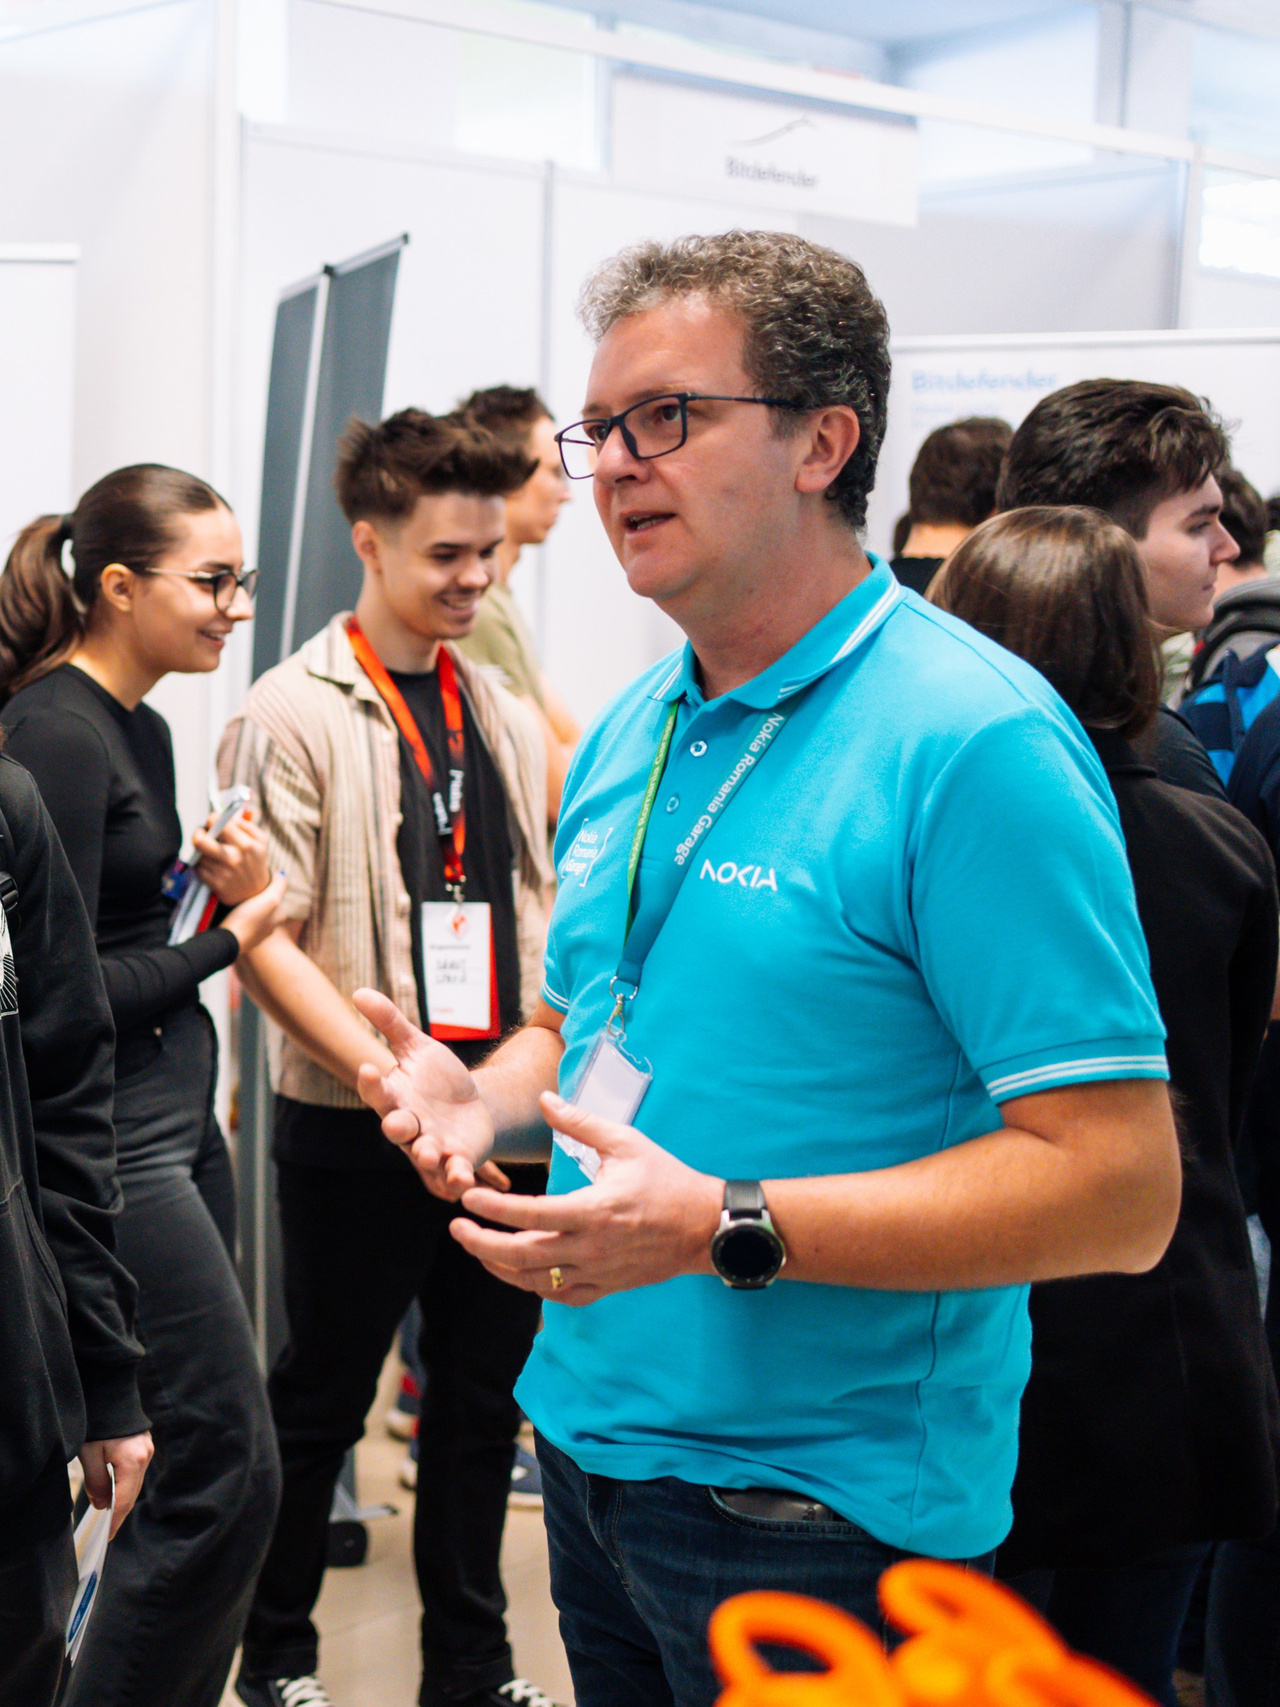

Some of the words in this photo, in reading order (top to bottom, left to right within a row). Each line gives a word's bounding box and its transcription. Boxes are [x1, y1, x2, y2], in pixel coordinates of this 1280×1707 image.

[725, 155, 819, 189] Bitdefender
[912, 369, 1057, 391] Bitdefender
[748, 712, 784, 752] Nokia
[707, 753, 756, 815] Romania
[674, 815, 713, 866] Garage
[700, 858, 778, 892] NOKIA
